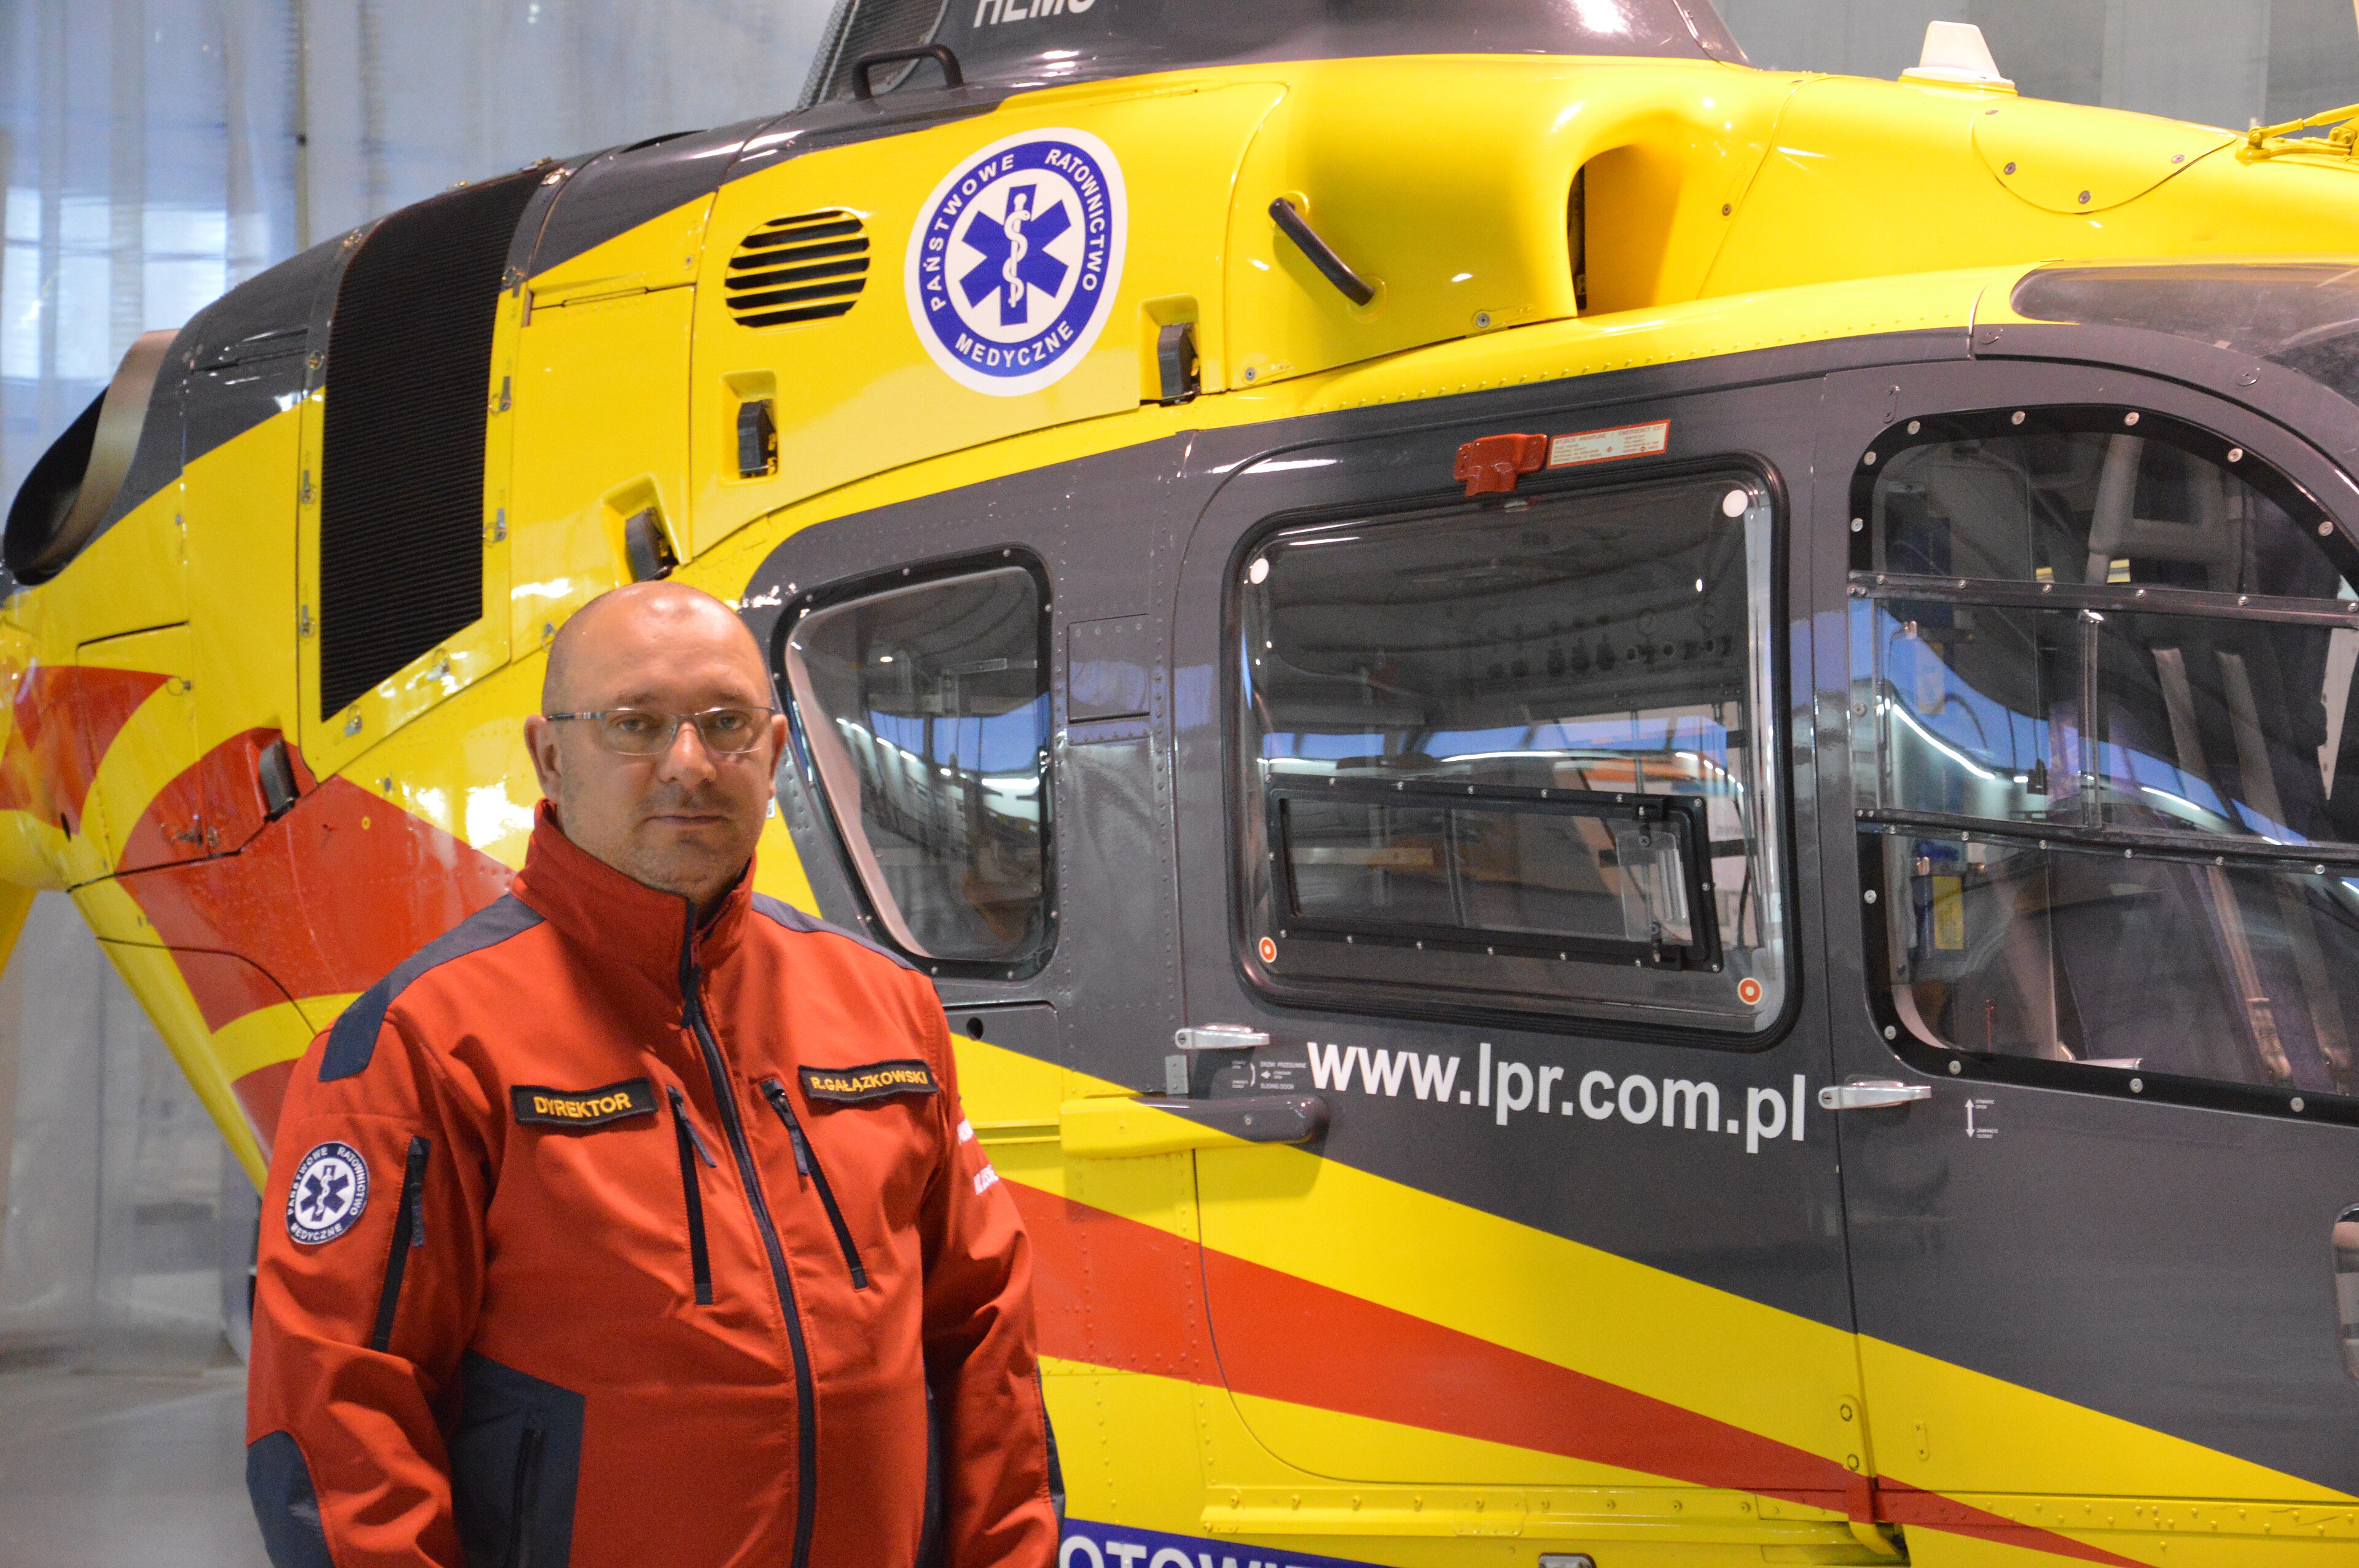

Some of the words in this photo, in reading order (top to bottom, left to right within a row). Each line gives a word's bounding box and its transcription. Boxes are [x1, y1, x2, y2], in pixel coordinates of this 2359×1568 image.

[923, 154, 1015, 311] PAŃSTWOWE
[1045, 149, 1106, 291] RATOWNICTWO
[955, 321, 1074, 368] MEDYCZNE
[533, 1092, 632, 1118] DYREKTOR
[810, 1070, 928, 1092] R.GAŁĄZKOWSKI
[1307, 1042, 1806, 1153] www.lpr.com.pl
[337, 1146, 367, 1216] RATOWNICTWO
[291, 1223, 343, 1241] MEDYCZNE
